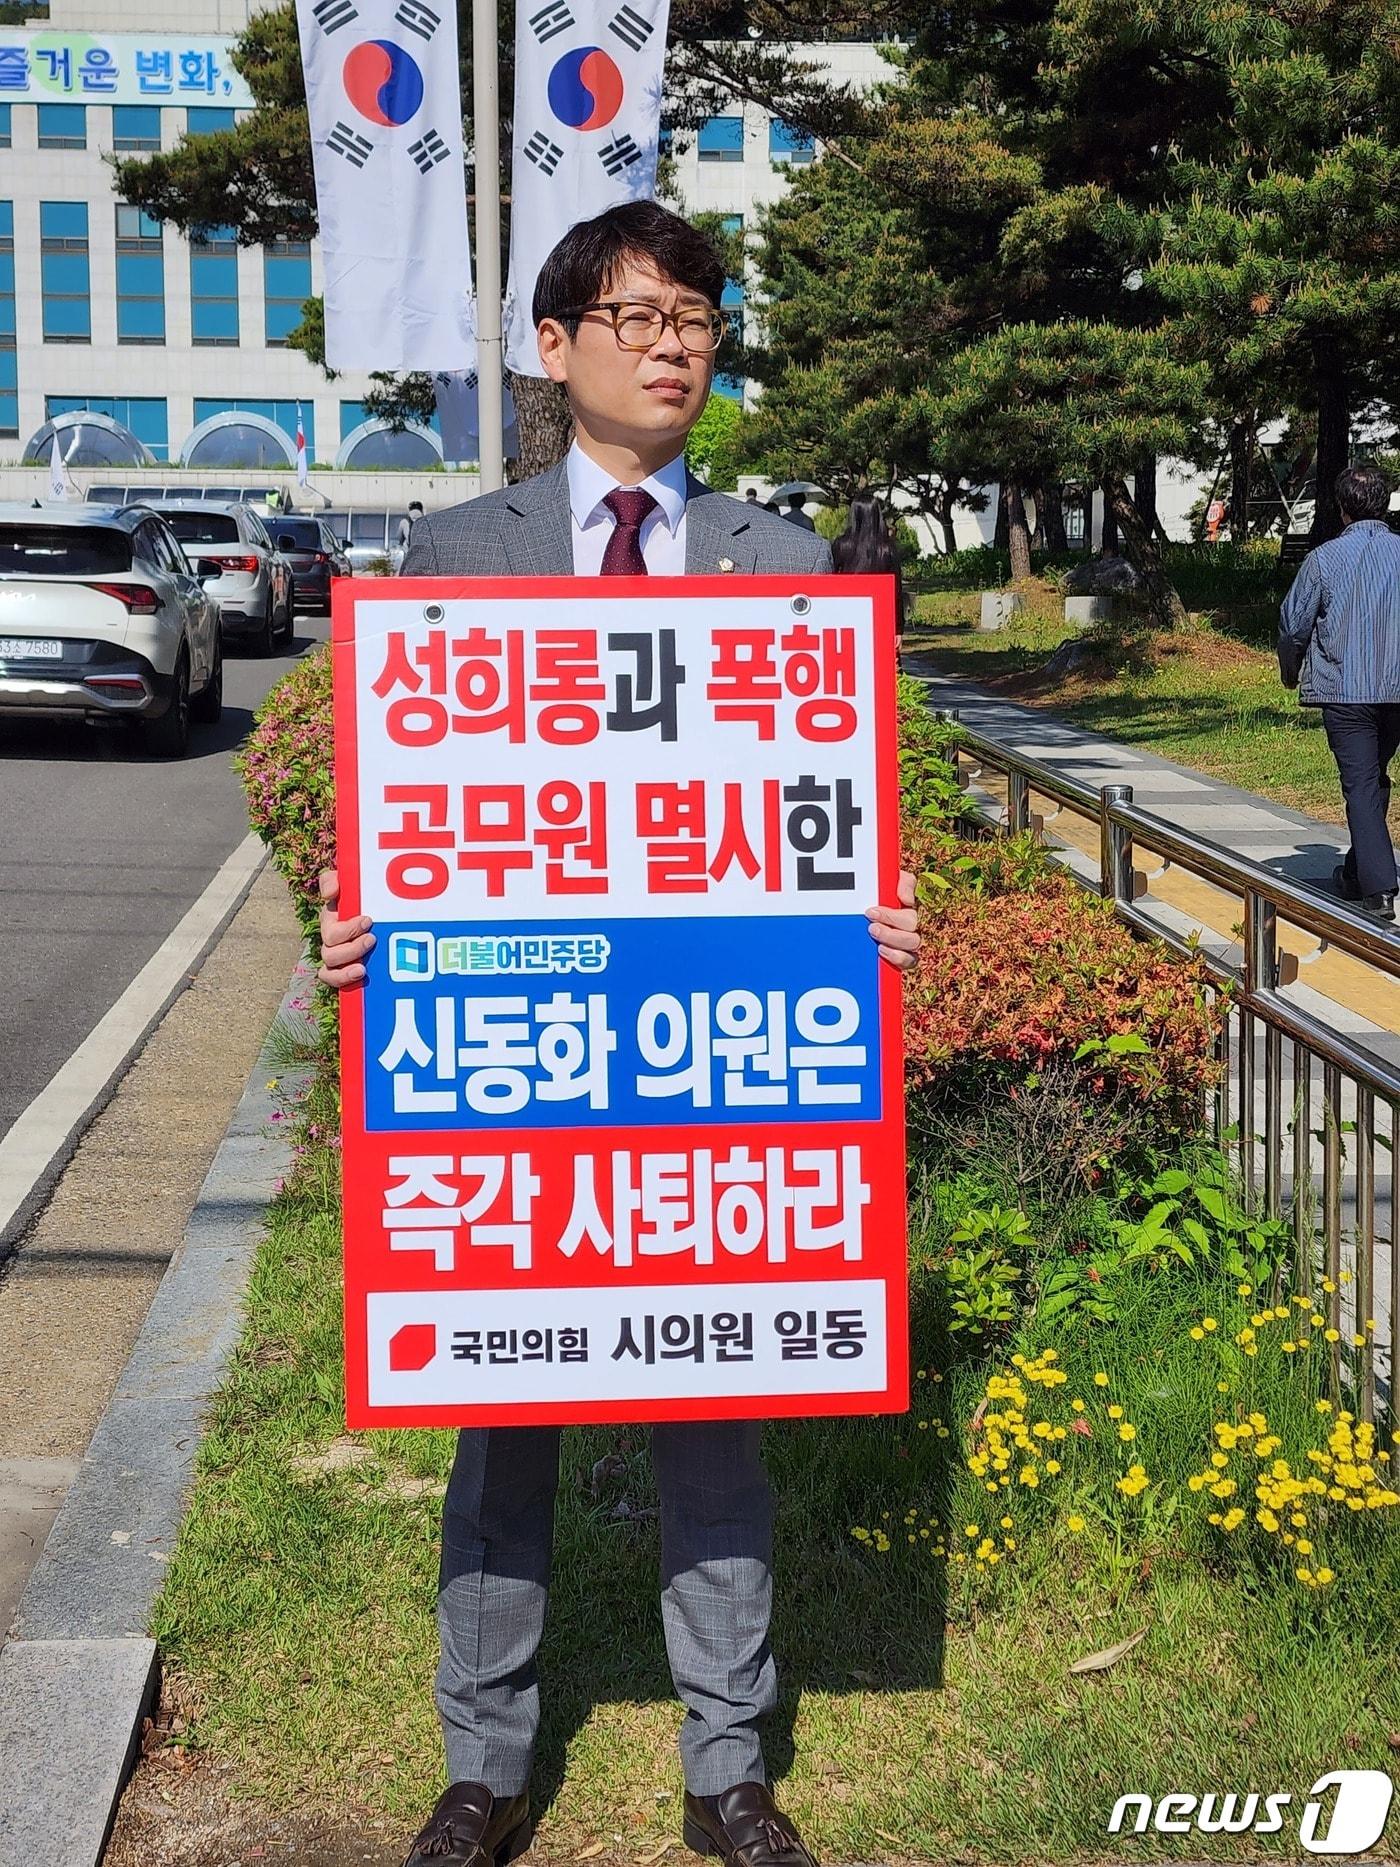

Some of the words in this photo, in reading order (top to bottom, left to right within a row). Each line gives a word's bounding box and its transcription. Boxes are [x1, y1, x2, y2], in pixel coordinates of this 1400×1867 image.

[0, 46, 118, 92] 즐거운
[135, 49, 233, 95] 변화,
[0, 640, 21, 653] 3소
[371, 627, 686, 747] 성희롱과
[706, 625, 858, 743] 폭행
[378, 779, 608, 899] 공무원
[635, 775, 862, 894] 멸시한
[440, 938, 606, 970] 더불어민주당
[378, 991, 617, 1114] 신동화
[636, 987, 867, 1108] 의원은
[382, 1152, 541, 1272] 즉각
[557, 1145, 871, 1267] 사퇴하라
[450, 1327, 589, 1365] 국민의힘
[611, 1312, 755, 1365] 시의원
[773, 1310, 867, 1360] 일동
